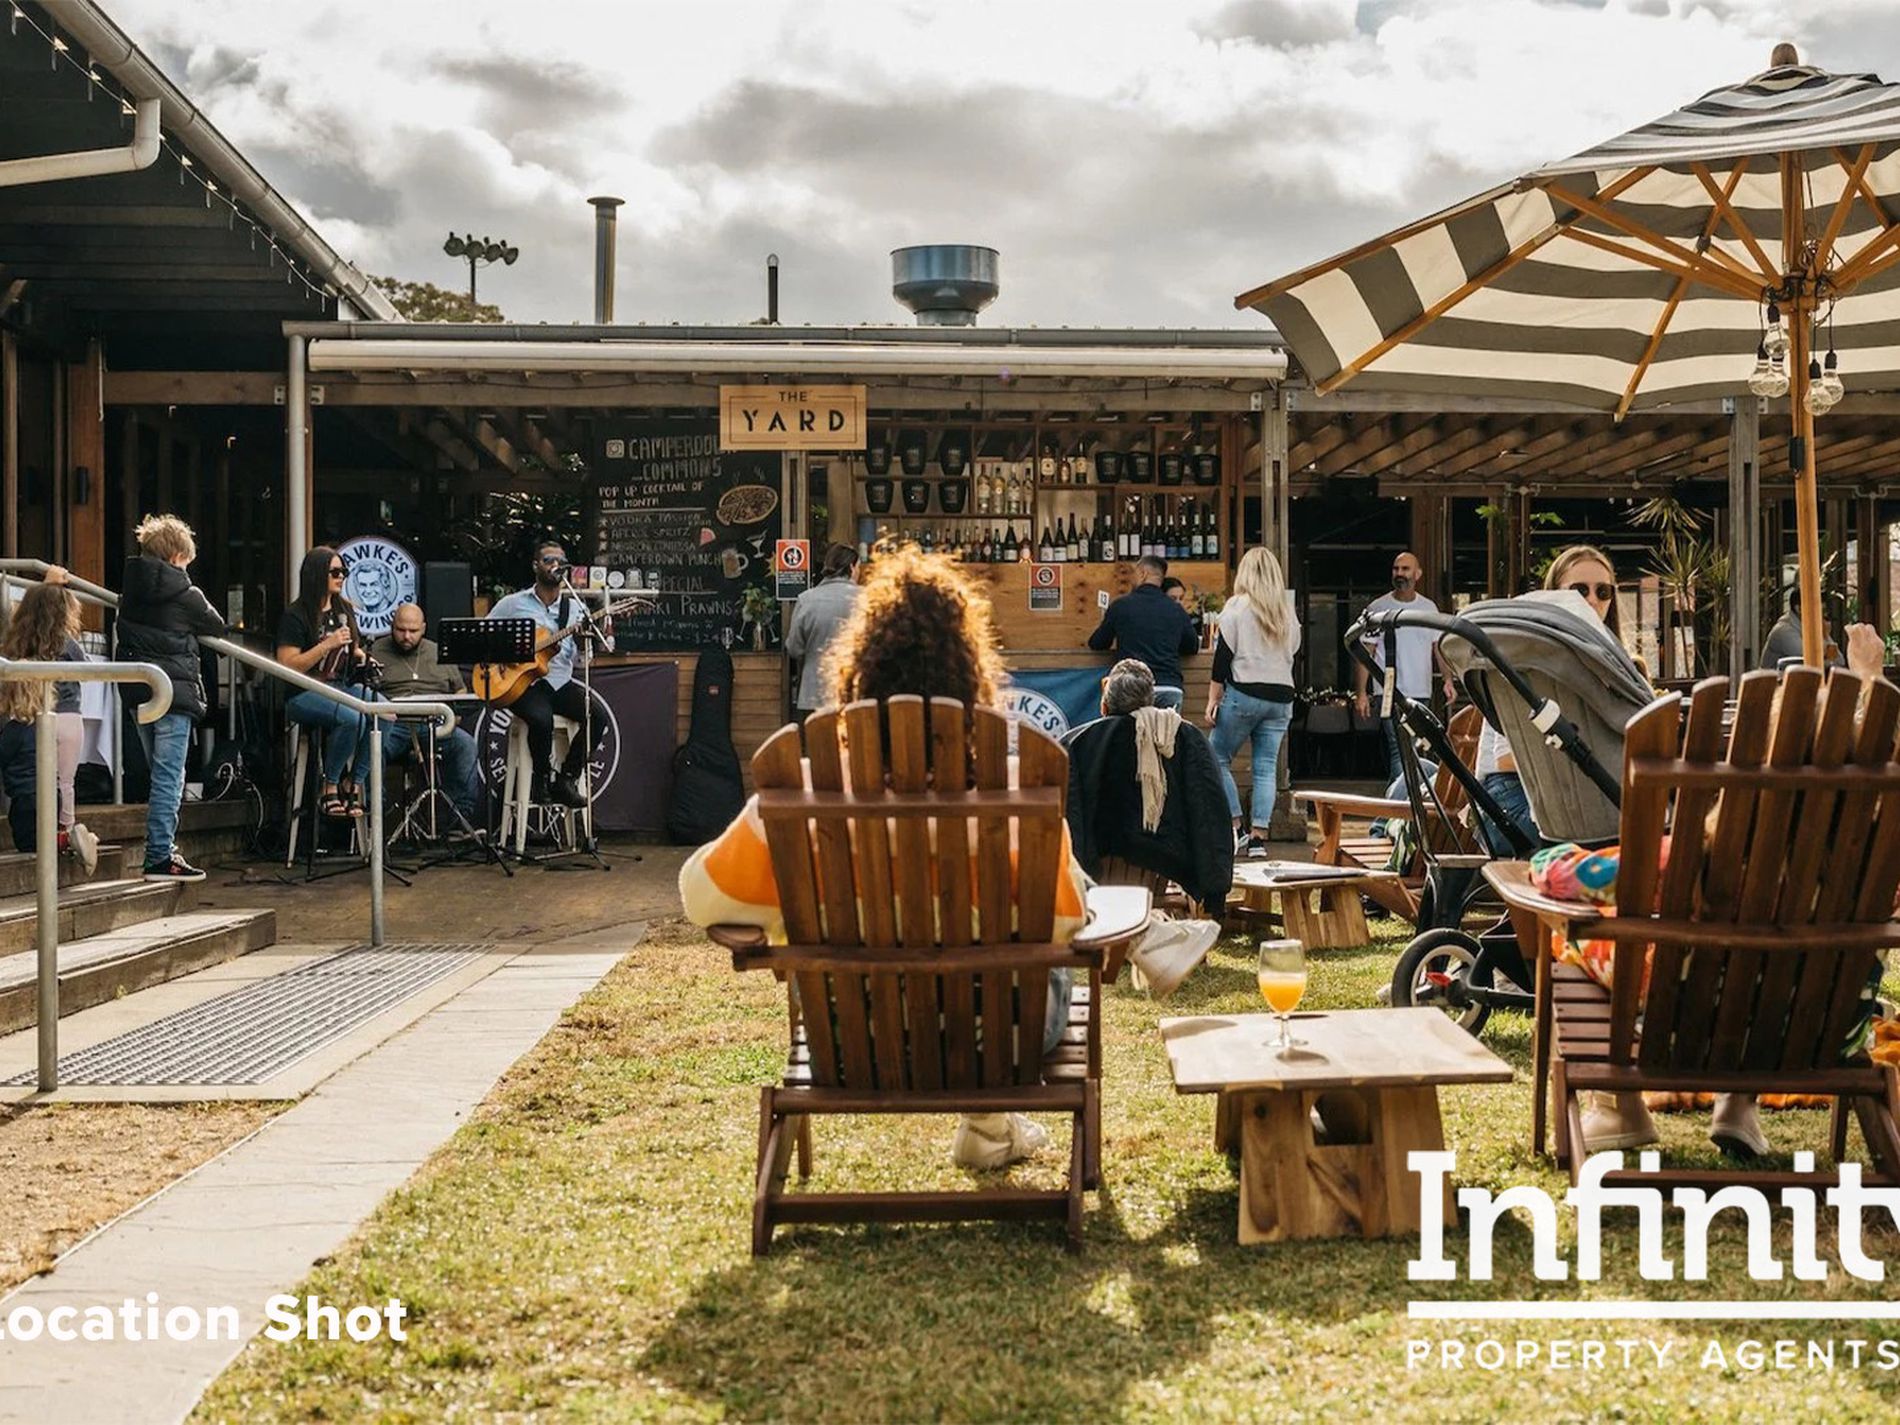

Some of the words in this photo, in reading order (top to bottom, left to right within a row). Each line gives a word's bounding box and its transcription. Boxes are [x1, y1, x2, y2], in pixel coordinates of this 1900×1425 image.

[778, 391, 807, 402] THE
[742, 409, 845, 432] YARD
[628, 434, 737, 460] CAMPERDO
[599, 486, 619, 497] POP
[624, 486, 638, 496] UP
[623, 497, 660, 509] MONTH
[342, 544, 409, 575] AWKE'S
[661, 575, 704, 593] PECIAL
[681, 595, 733, 617] PRAWNS
